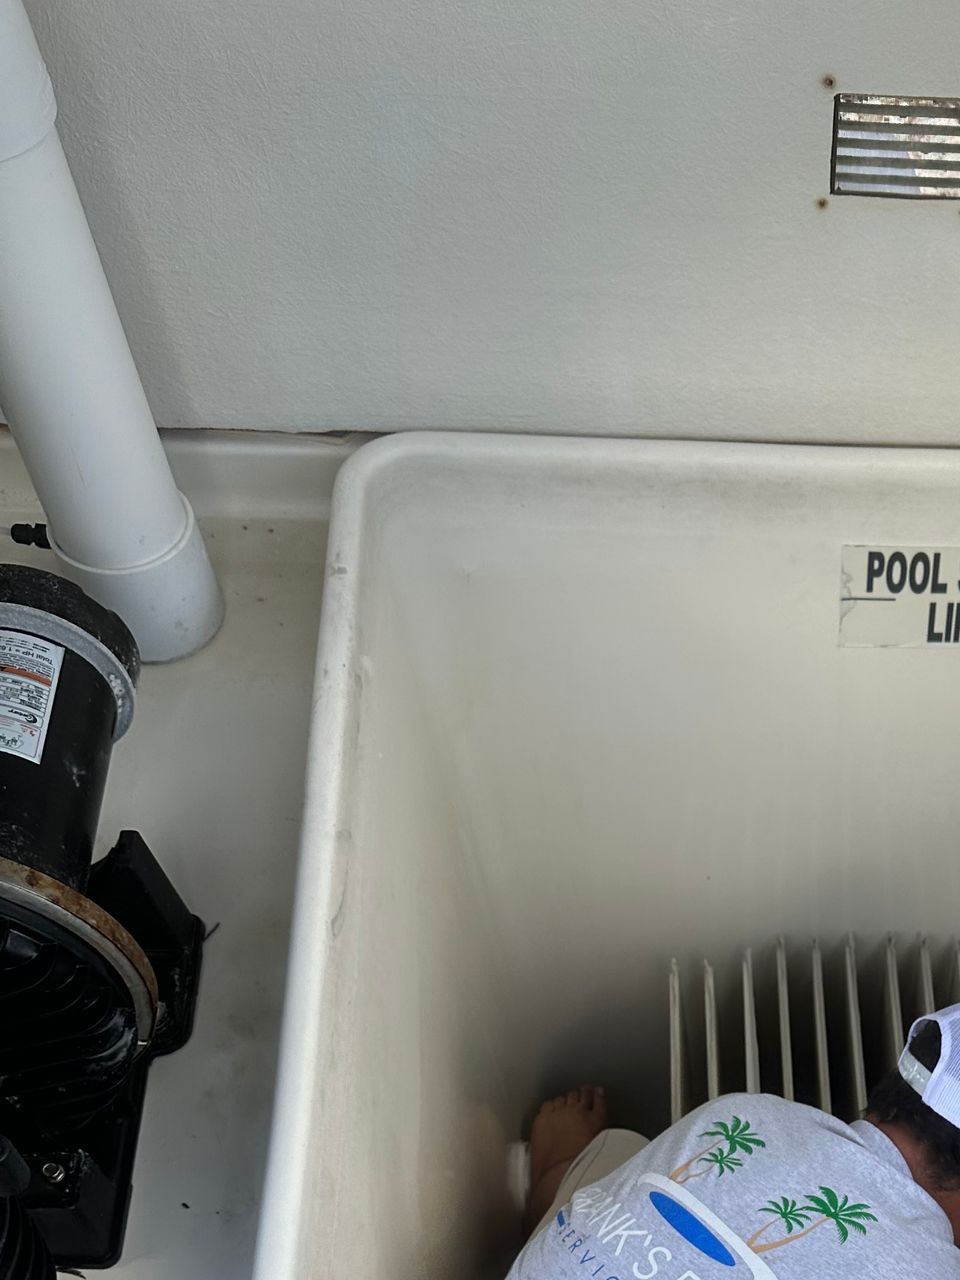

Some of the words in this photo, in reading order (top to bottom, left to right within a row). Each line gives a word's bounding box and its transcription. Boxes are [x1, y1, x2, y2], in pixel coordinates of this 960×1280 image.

[866, 551, 948, 594] POOL
[22, 650, 35, 658] HP
[36, 653, 54, 666] Total
